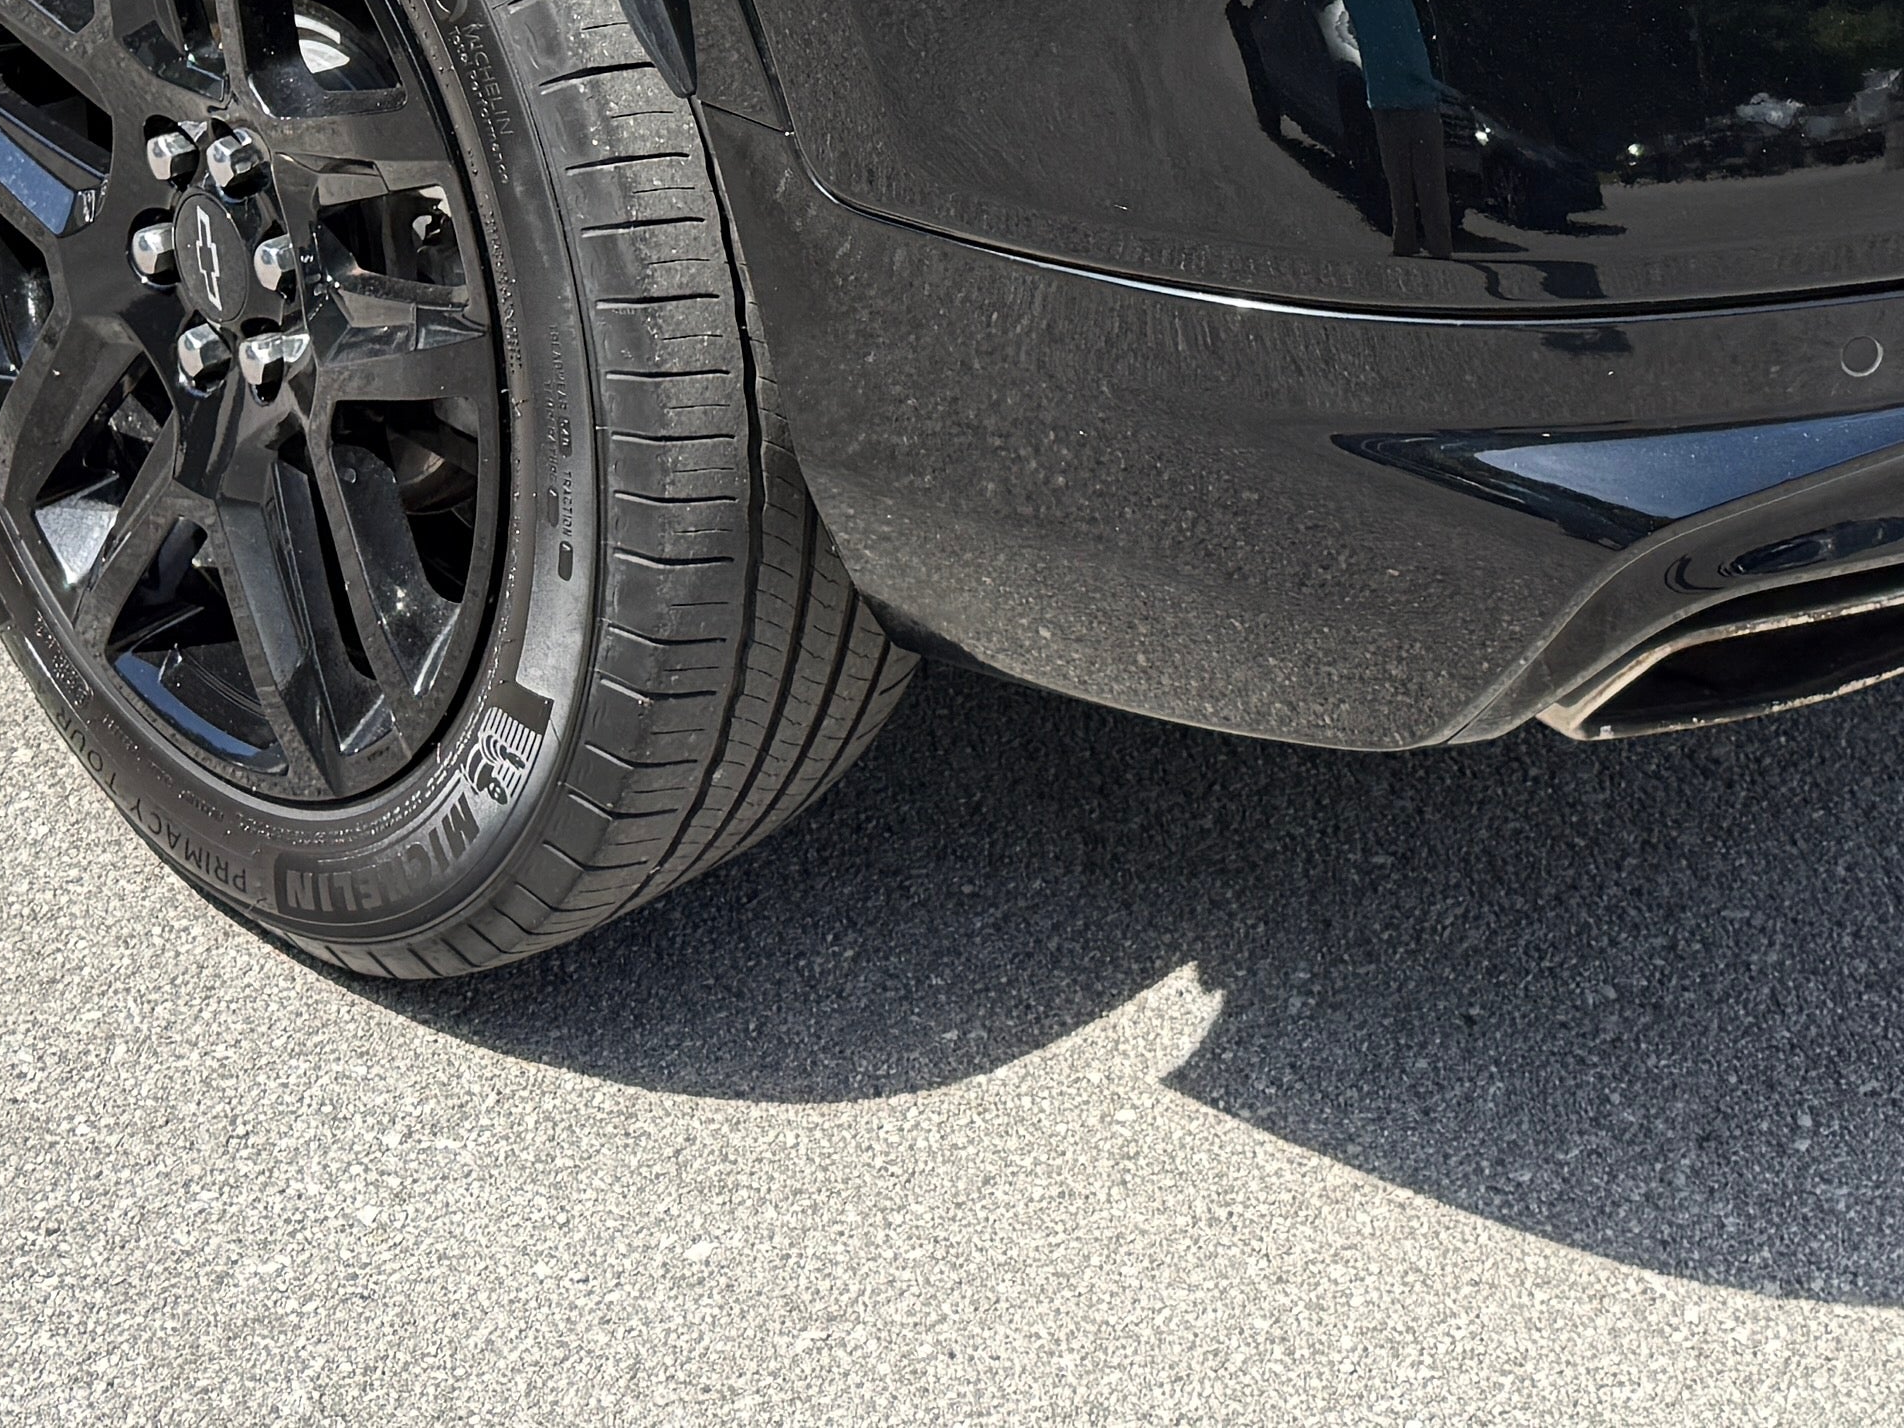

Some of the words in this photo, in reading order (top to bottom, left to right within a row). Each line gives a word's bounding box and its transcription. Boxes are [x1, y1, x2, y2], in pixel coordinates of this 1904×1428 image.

[461, 22, 515, 137] MICHELIN
[56, 706, 118, 796] TOUR
[131, 796, 248, 894] PRIMACY
[284, 789, 482, 913] MICHELIN
